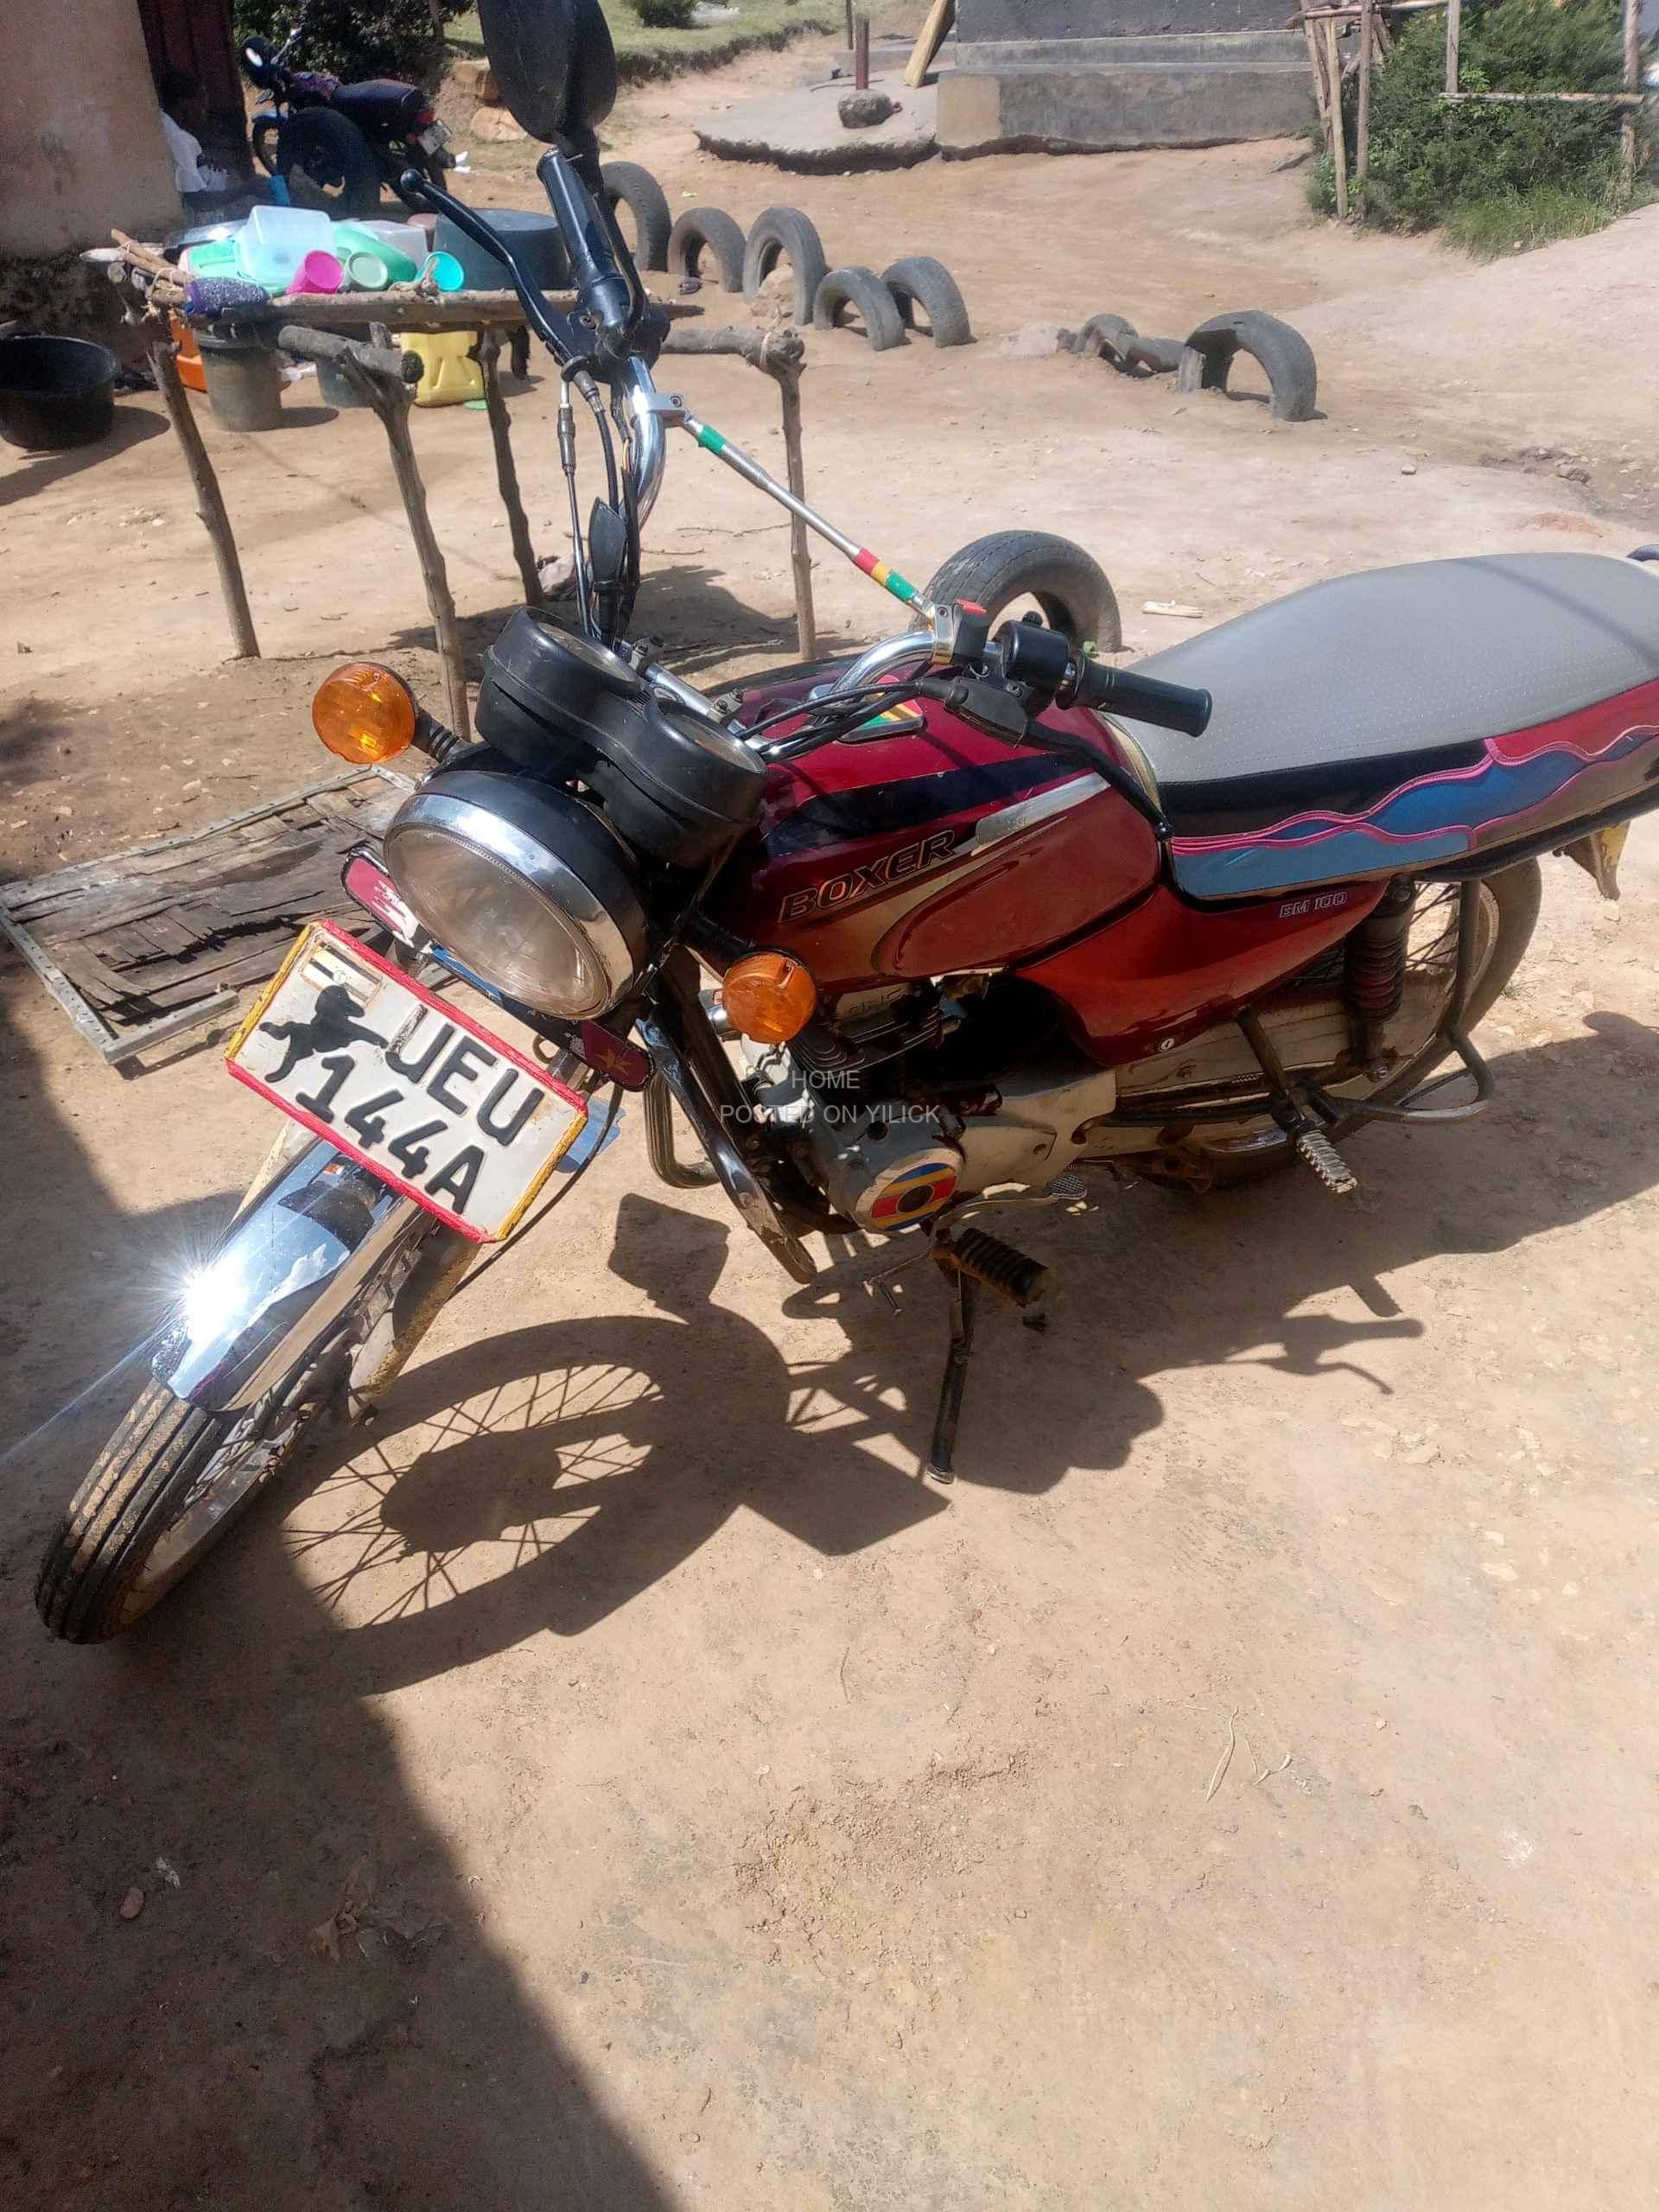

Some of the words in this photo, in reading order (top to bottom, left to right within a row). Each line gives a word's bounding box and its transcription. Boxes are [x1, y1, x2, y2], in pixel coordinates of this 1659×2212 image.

[779, 830, 959, 923] BOXER
[1314, 892, 1348, 910] 100
[296, 1055, 486, 1214] 144A
